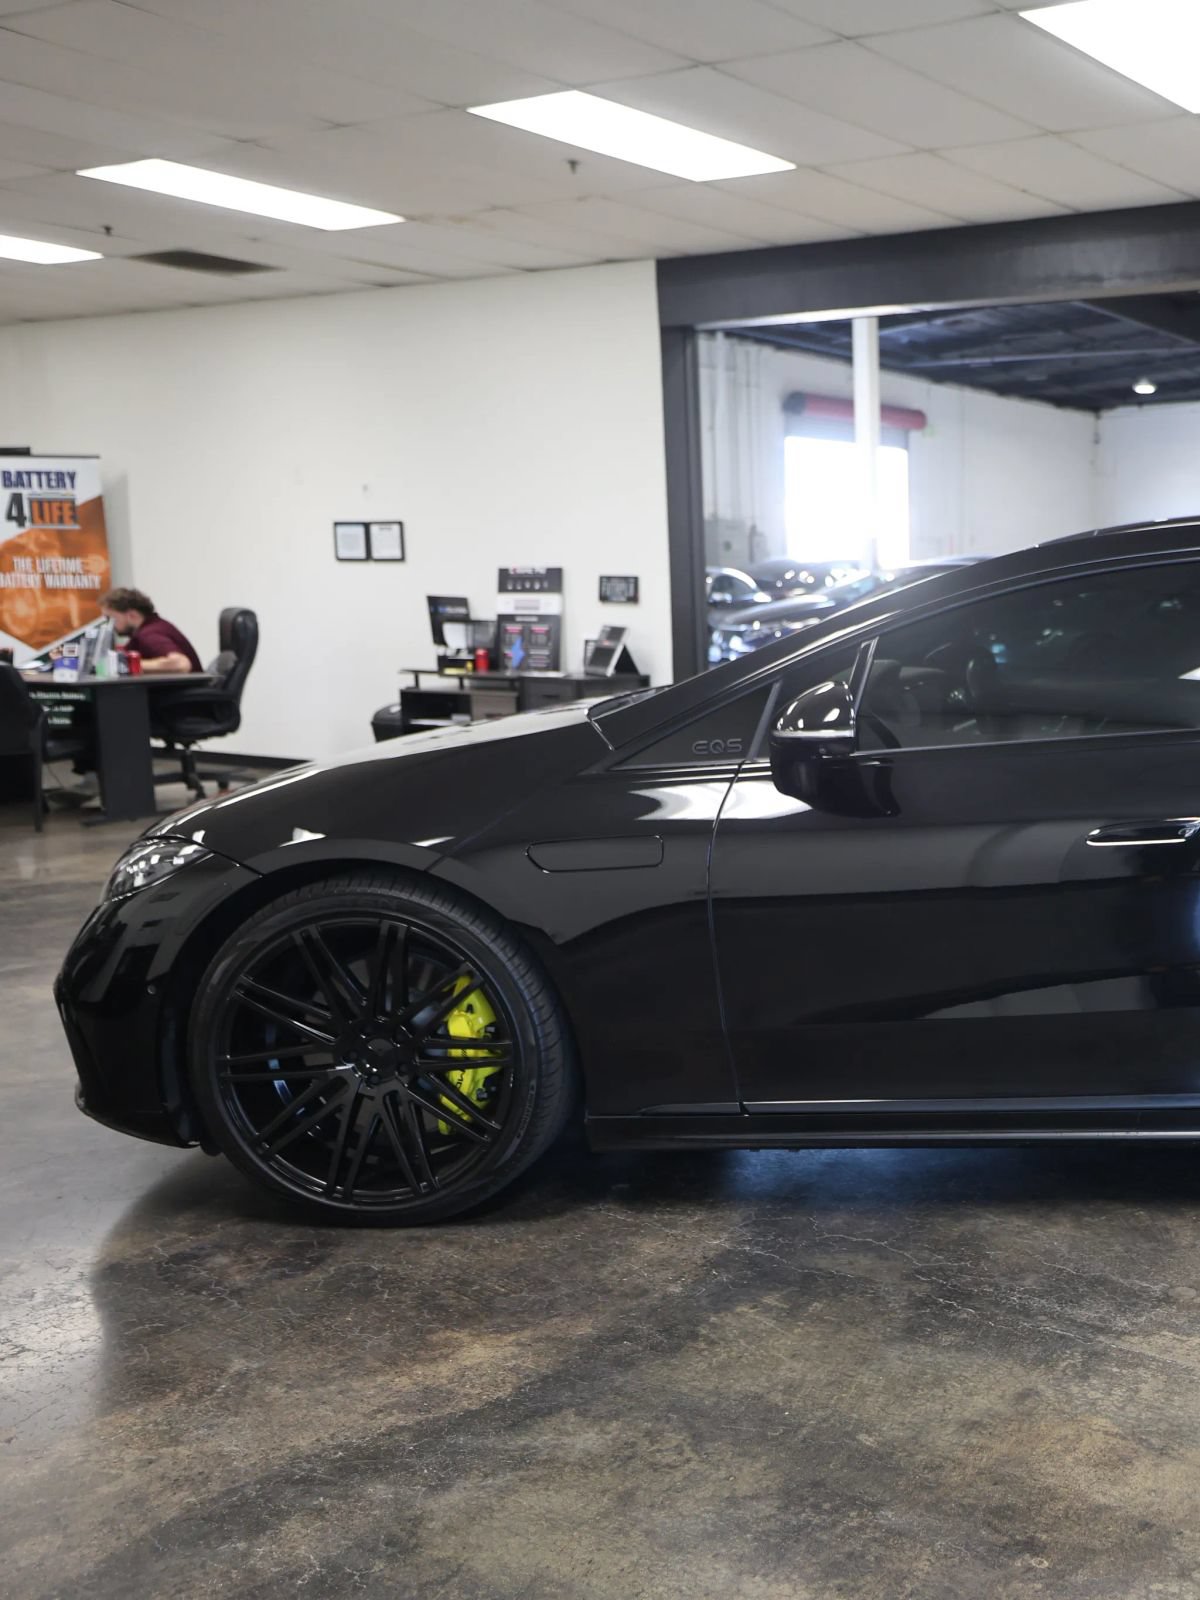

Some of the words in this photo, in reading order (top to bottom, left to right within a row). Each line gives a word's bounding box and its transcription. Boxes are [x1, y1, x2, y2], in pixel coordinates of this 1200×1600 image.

[2, 470, 76, 489] BATTERY
[6, 493, 27, 528] 4
[31, 500, 75, 526] LIFE
[13, 557, 33, 573] THE
[36, 557, 83, 574] LIFETIME
[44, 574, 101, 589] WARRANTY
[692, 738, 742, 755] EQS
